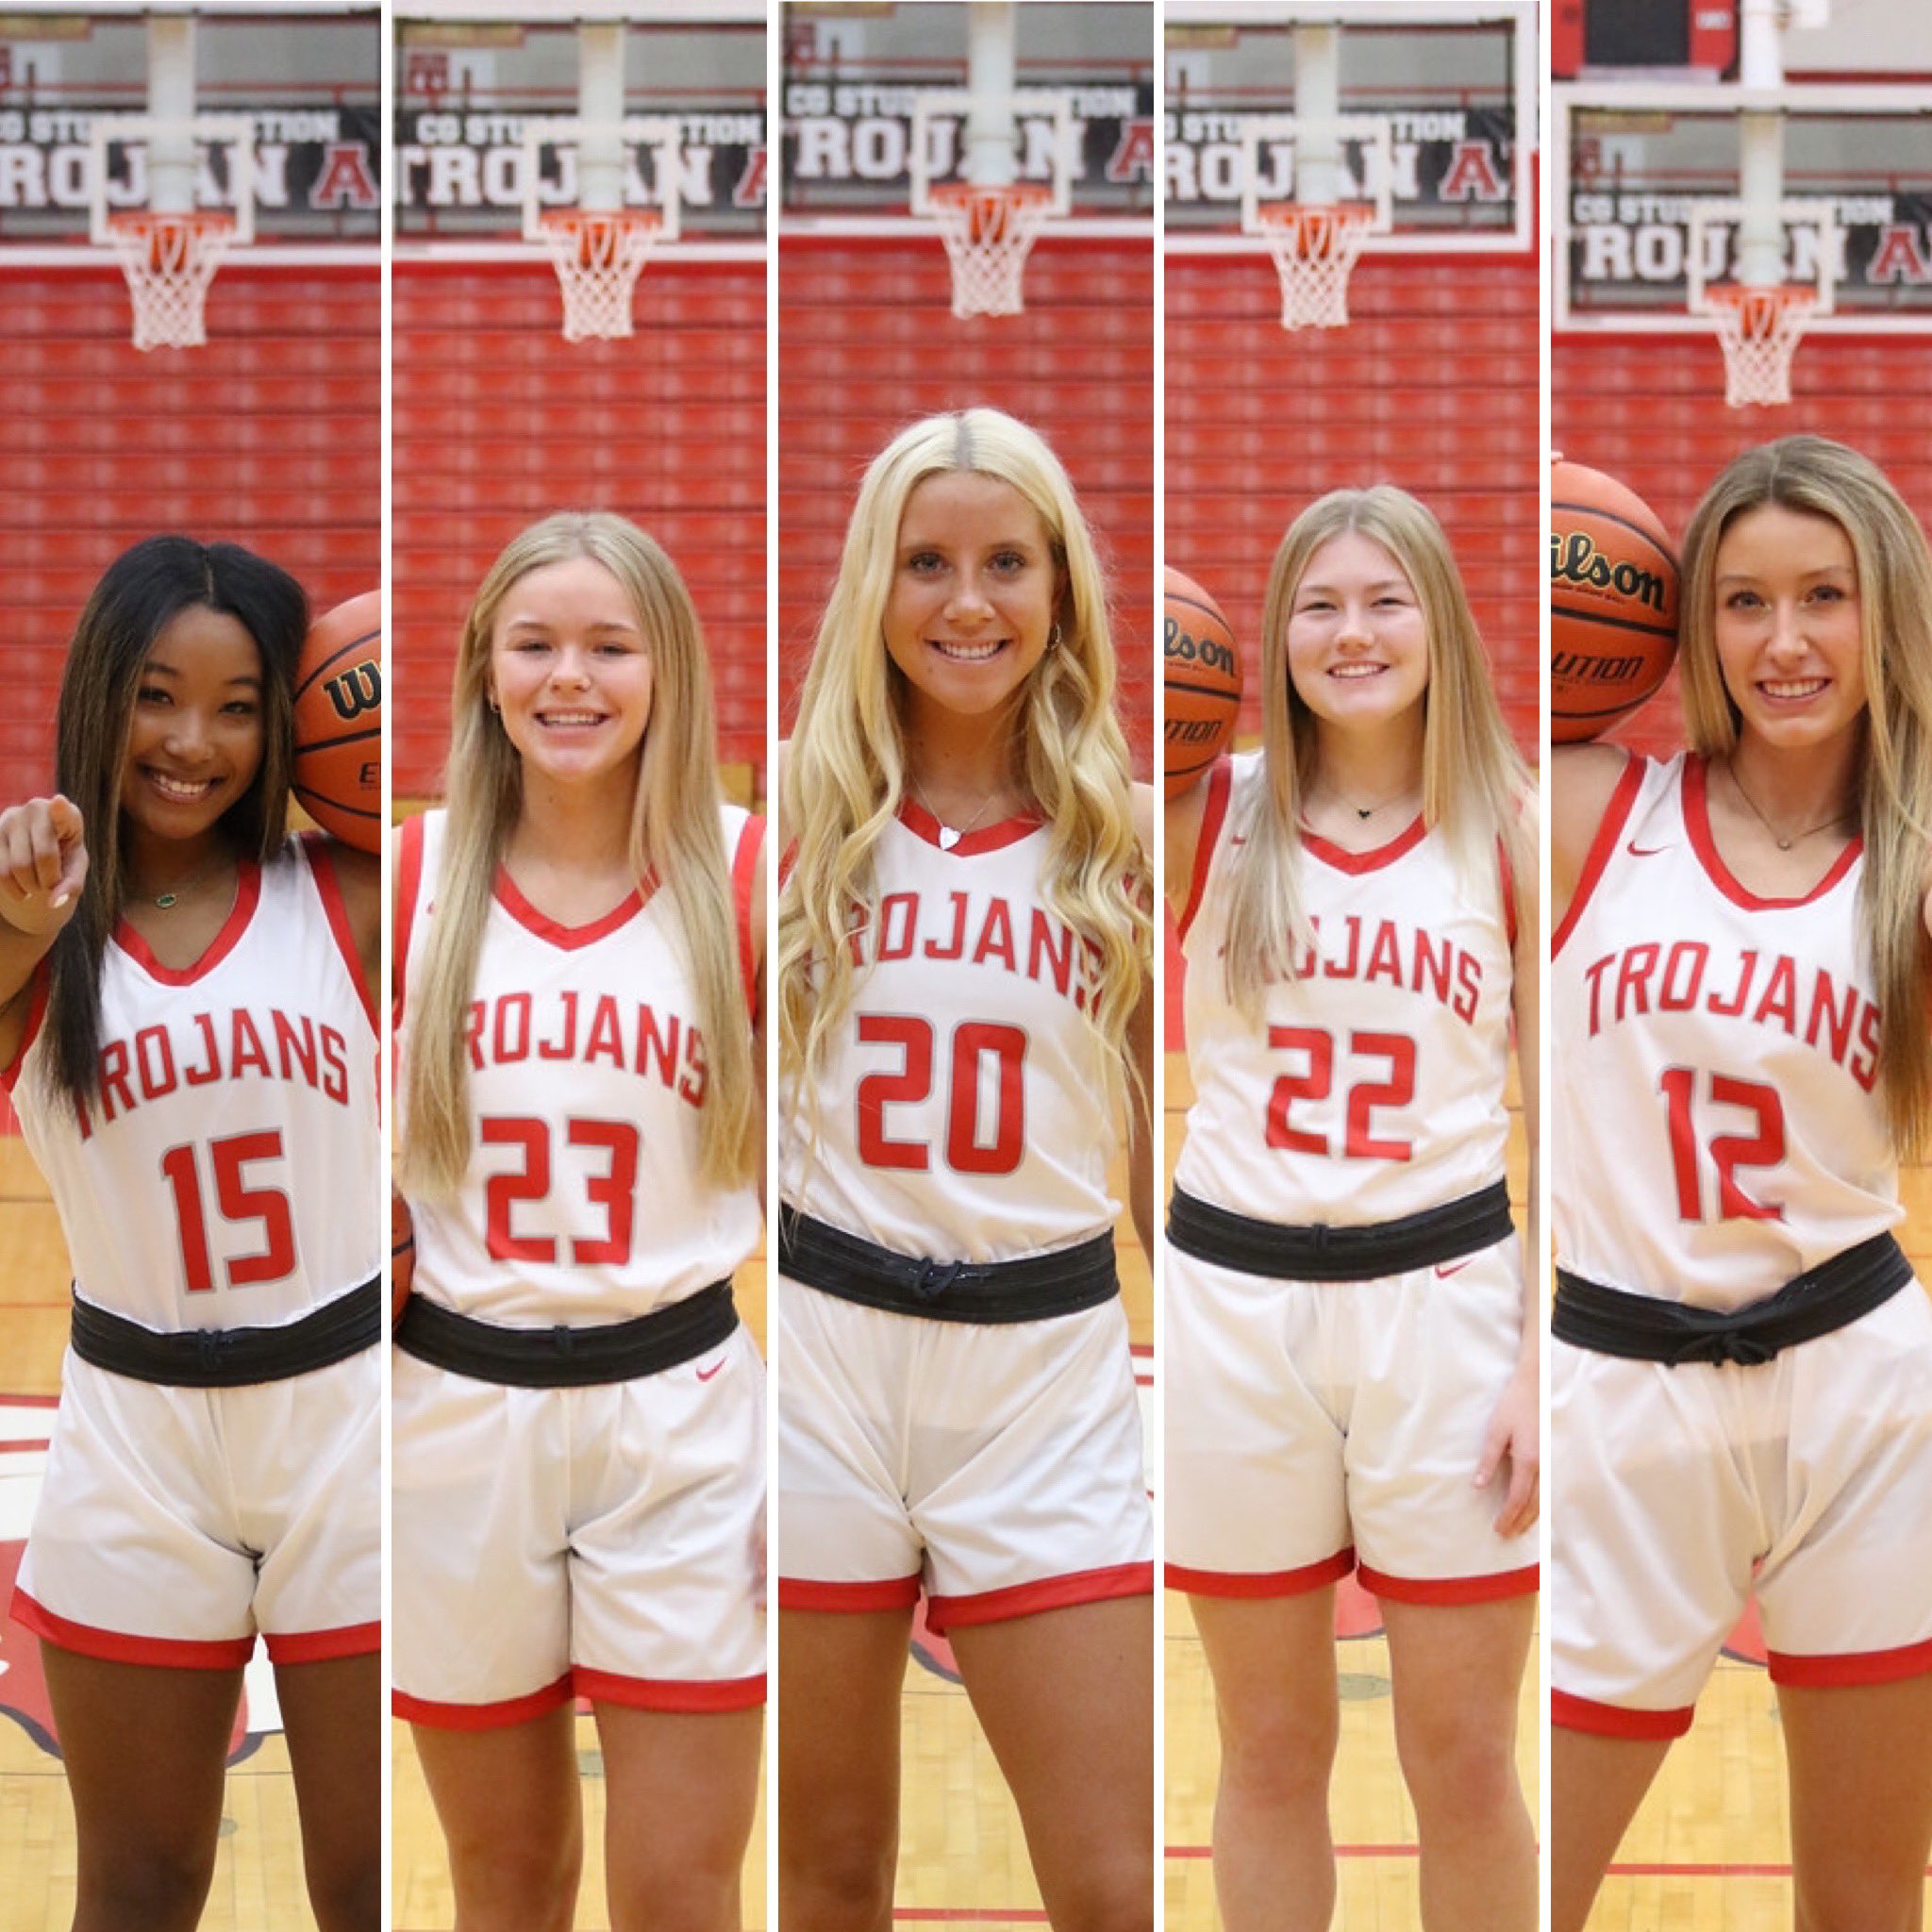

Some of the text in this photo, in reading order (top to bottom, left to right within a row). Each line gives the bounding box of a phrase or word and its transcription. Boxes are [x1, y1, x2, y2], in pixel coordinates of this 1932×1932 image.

[1439, 140, 1510, 203] A
[1865, 221, 1932, 286] A
[323, 658, 381, 723] W
[462, 991, 710, 1109] ROJANS
[1585, 940, 1884, 1094] TROJANS
[854, 1011, 1030, 1176] 20
[1264, 1024, 1418, 1164] 22
[1657, 1063, 1790, 1225] 12
[159, 1126, 300, 1293] 15
[479, 1113, 641, 1268] 23
